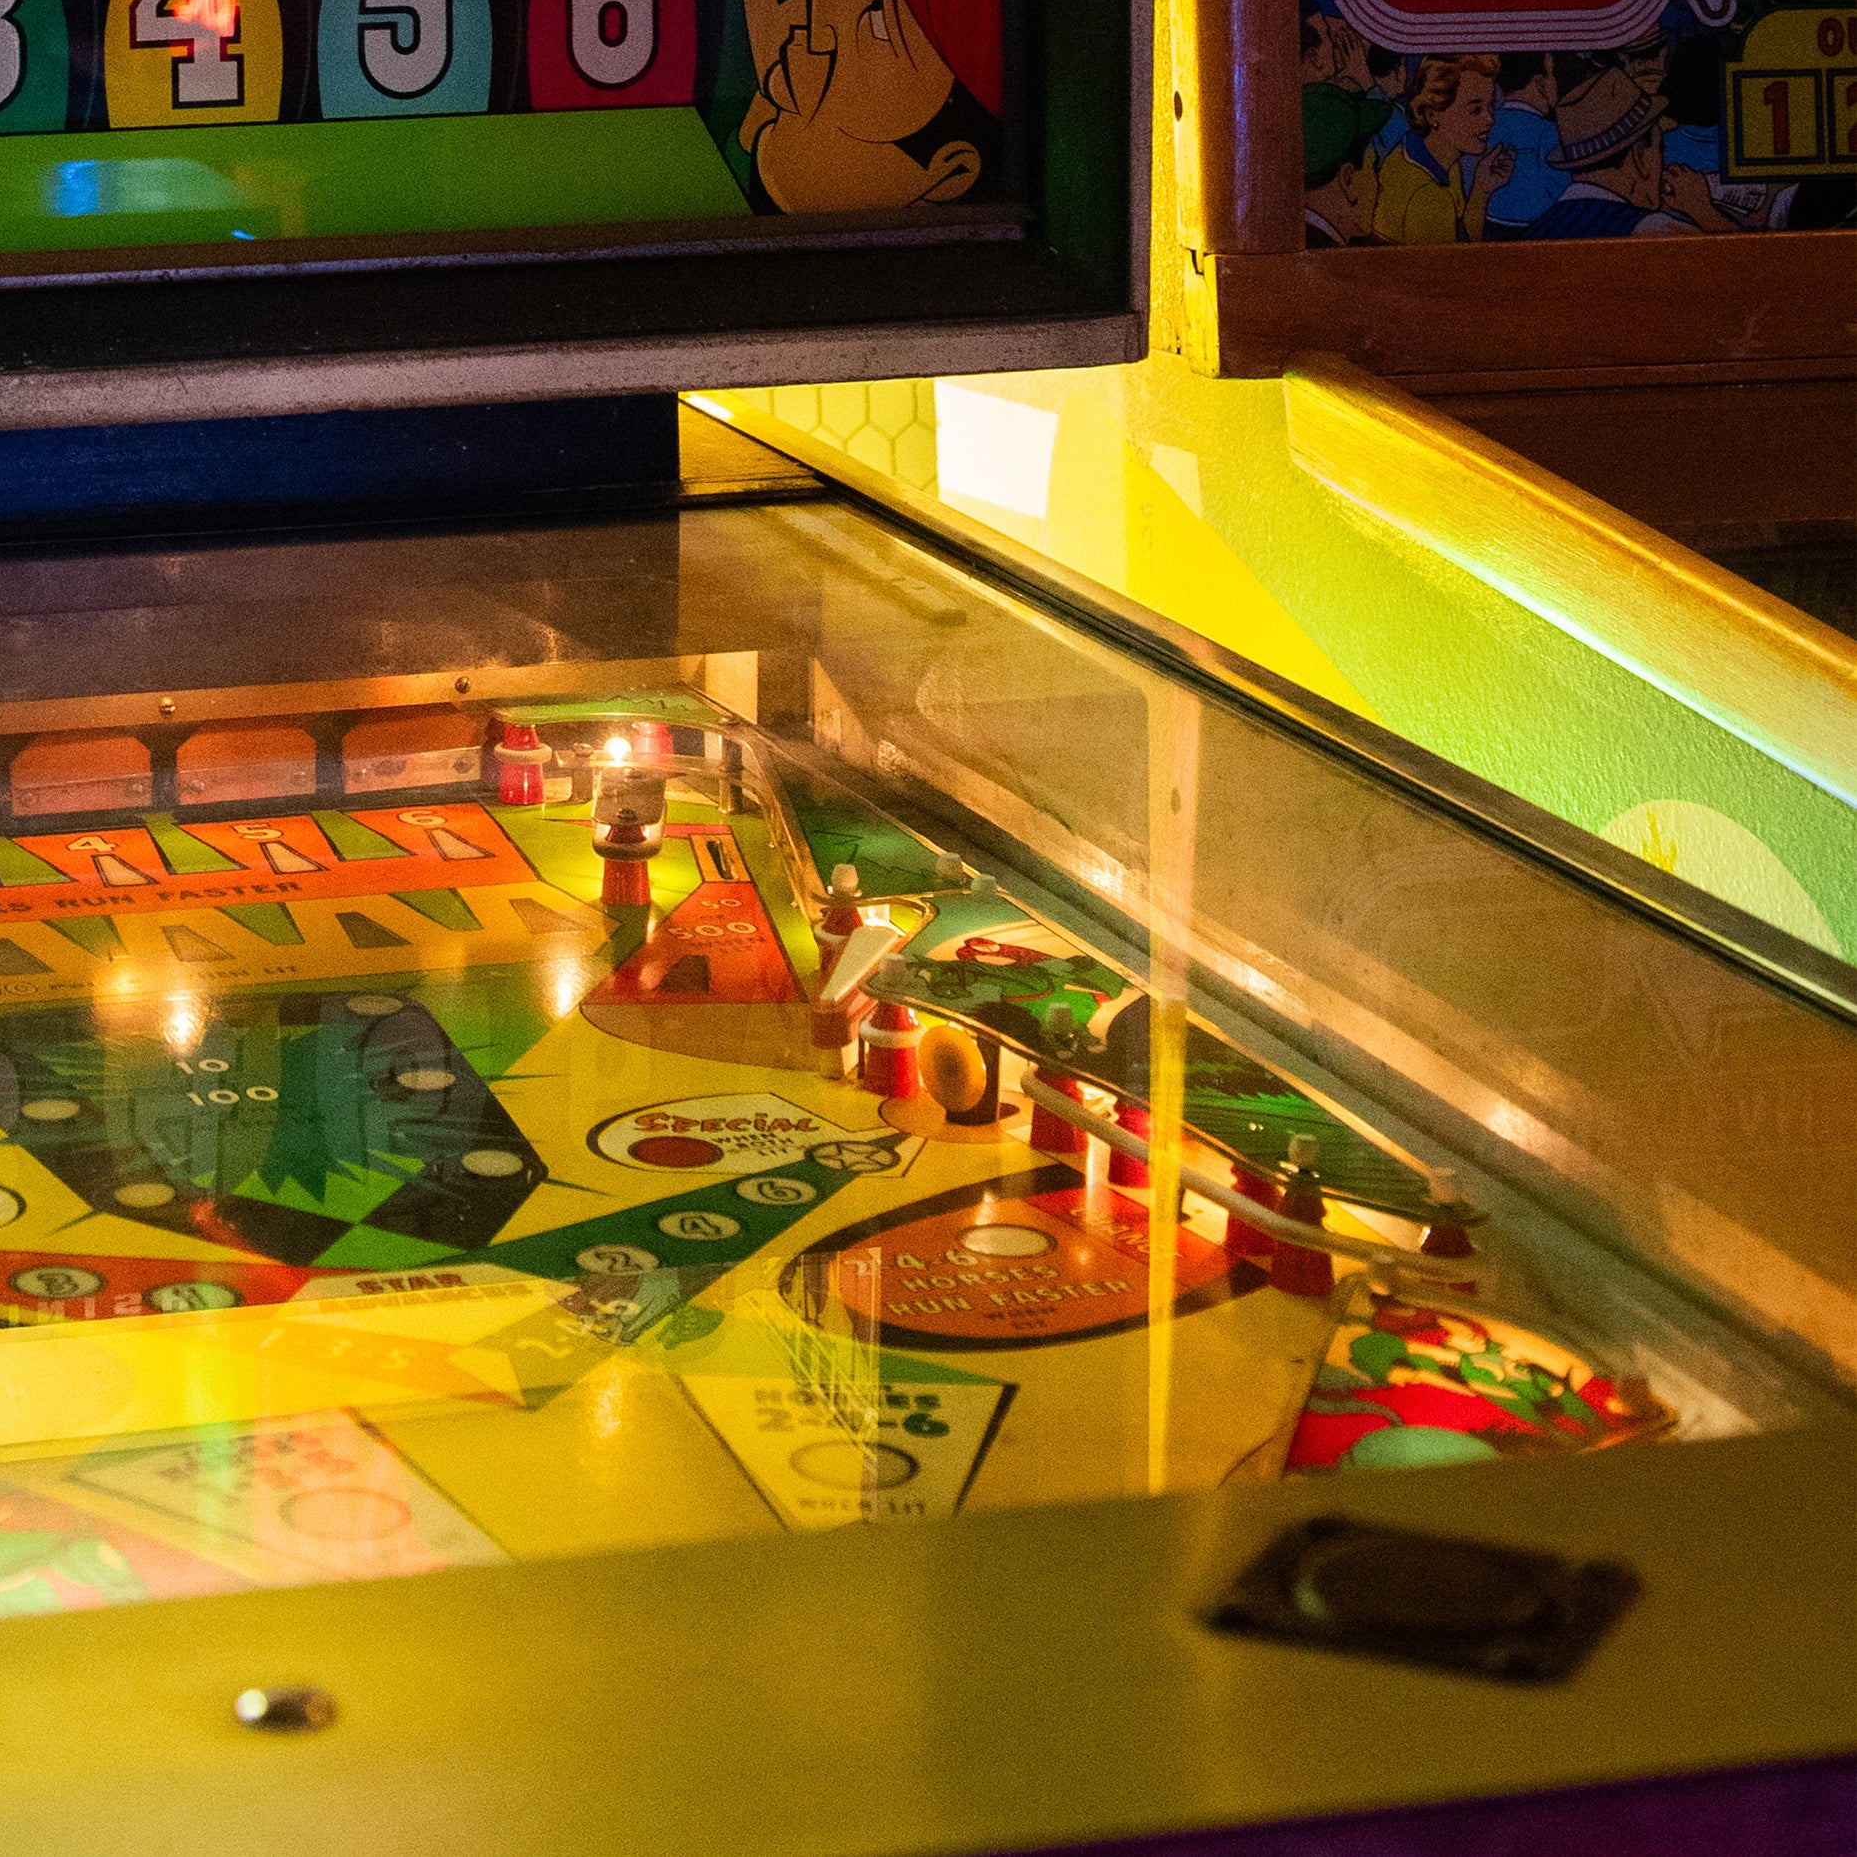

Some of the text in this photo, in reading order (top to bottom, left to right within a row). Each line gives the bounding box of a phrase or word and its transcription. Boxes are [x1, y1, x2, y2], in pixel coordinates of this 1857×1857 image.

[1763, 80, 1791, 156] 1
[398, 809, 447, 829] 6
[232, 823, 283, 841] 5
[67, 835, 118, 854] 4
[55, 893, 134, 909] RUN
[157, 882, 301, 901] FASTER
[669, 921, 758, 940] 500
[176, 1058, 230, 1075] 10
[186, 1085, 279, 1107] 100
[356, 1272, 468, 1295] STAR
[902, 1264, 1060, 1293] HORSES
[888, 1279, 1131, 1318] RUN FASTER
